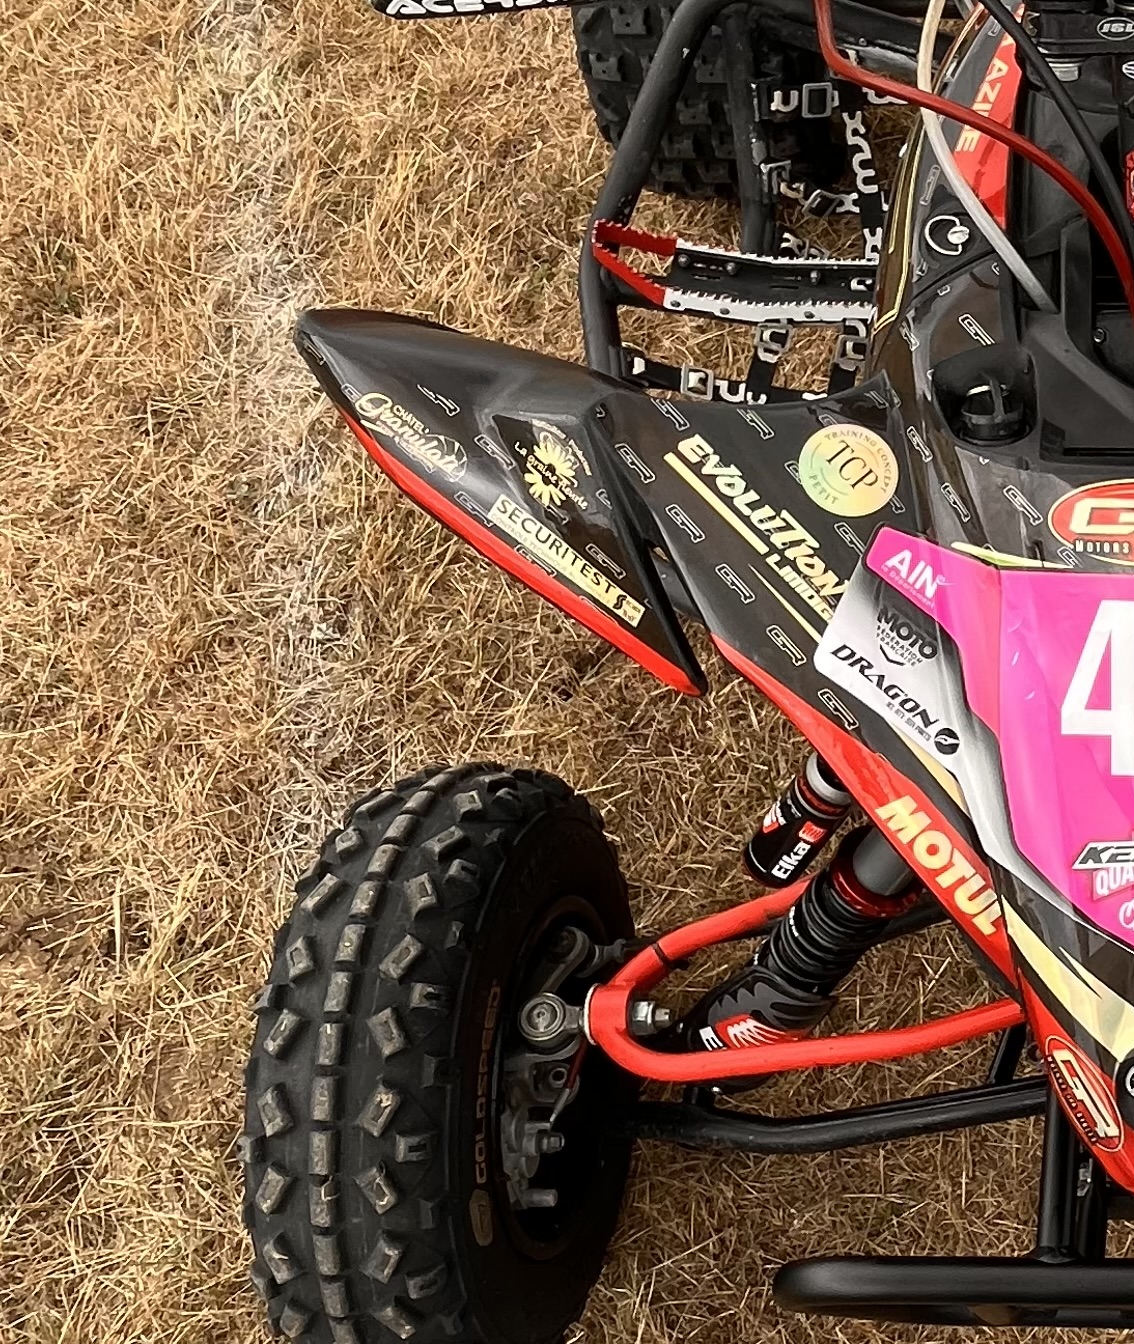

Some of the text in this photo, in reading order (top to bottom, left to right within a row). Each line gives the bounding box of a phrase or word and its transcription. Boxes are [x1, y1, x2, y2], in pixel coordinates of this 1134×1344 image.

[824, 430, 892, 494] TRAINING CONCEPT
[826, 440, 879, 489] TCP
[809, 474, 839, 504] PETIT
[496, 499, 617, 595] SECURITEST
[1075, 540, 1130, 554] MOTORS
[886, 549, 938, 599] AIN
[877, 606, 938, 659] MOTO
[831, 644, 939, 729] DRAGON
[771, 840, 811, 879] Elka
[875, 795, 1001, 936] MOTUL
[473, 979, 502, 1185] GOLDSPEED
